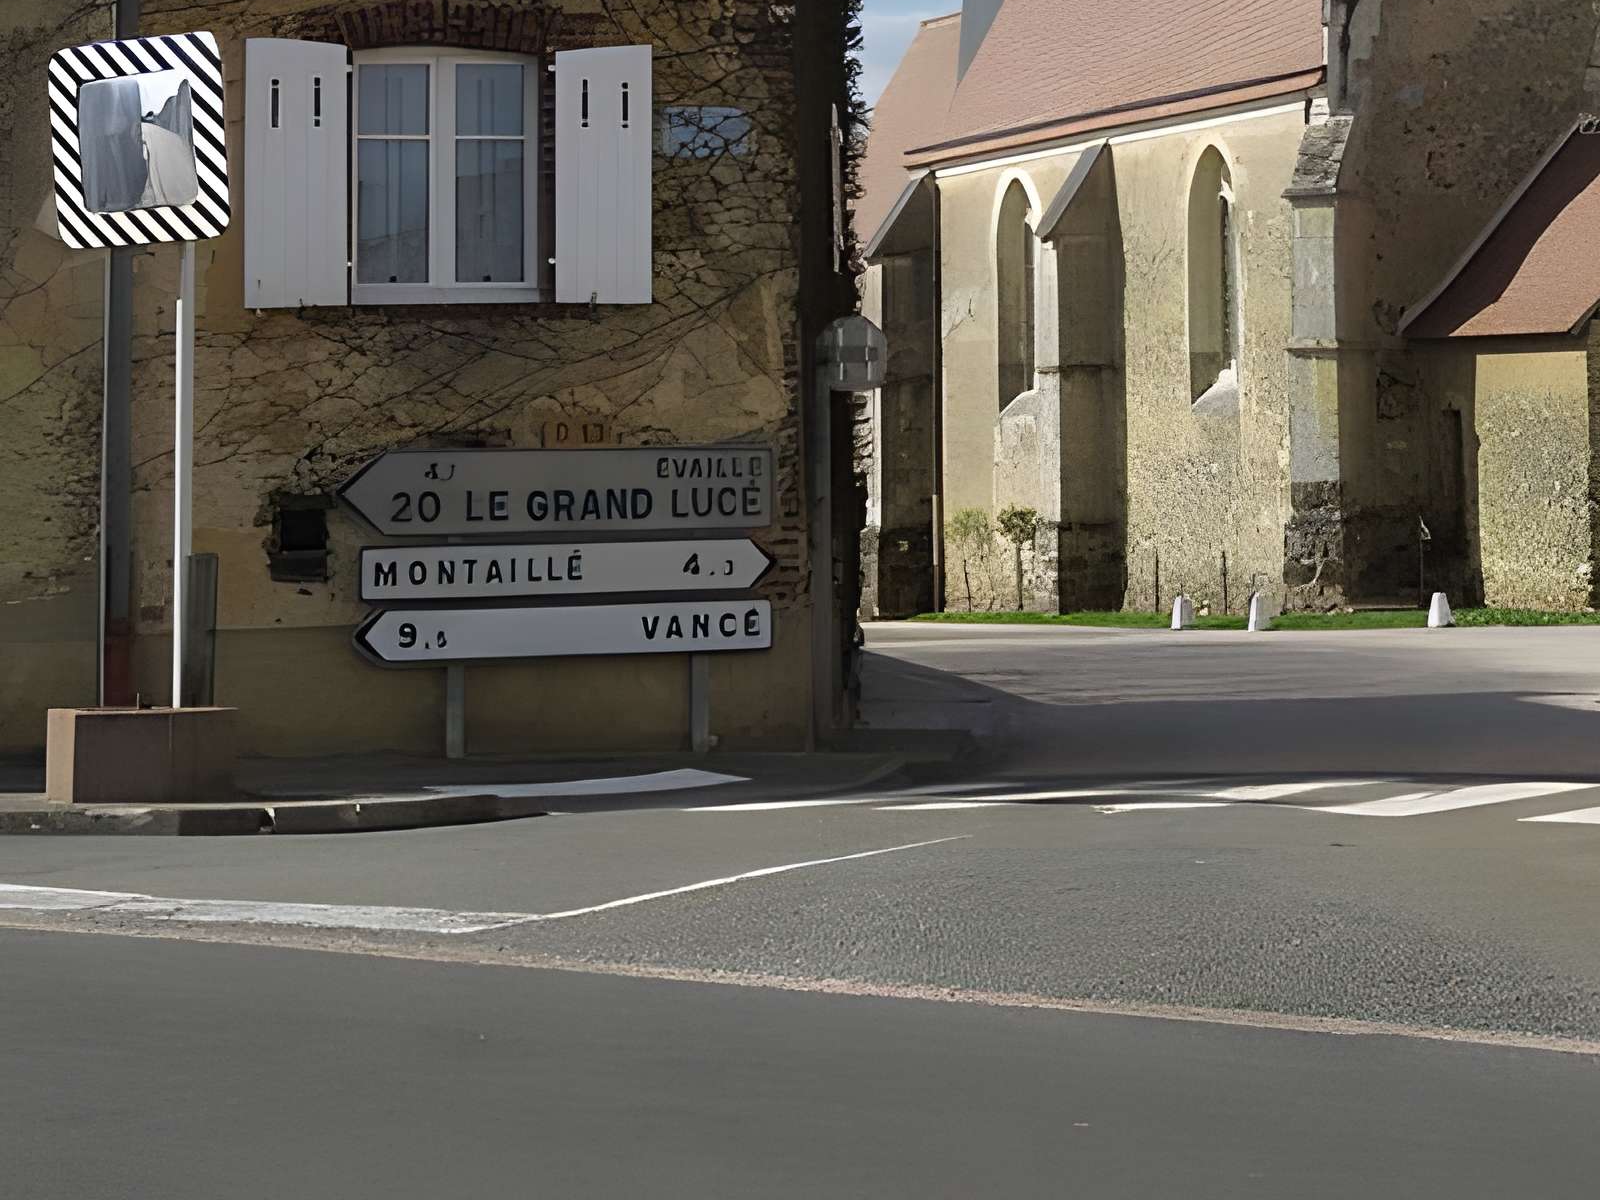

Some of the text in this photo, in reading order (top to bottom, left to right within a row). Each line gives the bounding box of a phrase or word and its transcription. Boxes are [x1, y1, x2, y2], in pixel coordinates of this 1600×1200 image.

[390, 479, 762, 522] 20 LE GRAND LUCÉ
[373, 549, 583, 587] MONTAILLÉ
[641, 608, 761, 639] VANCÉ
